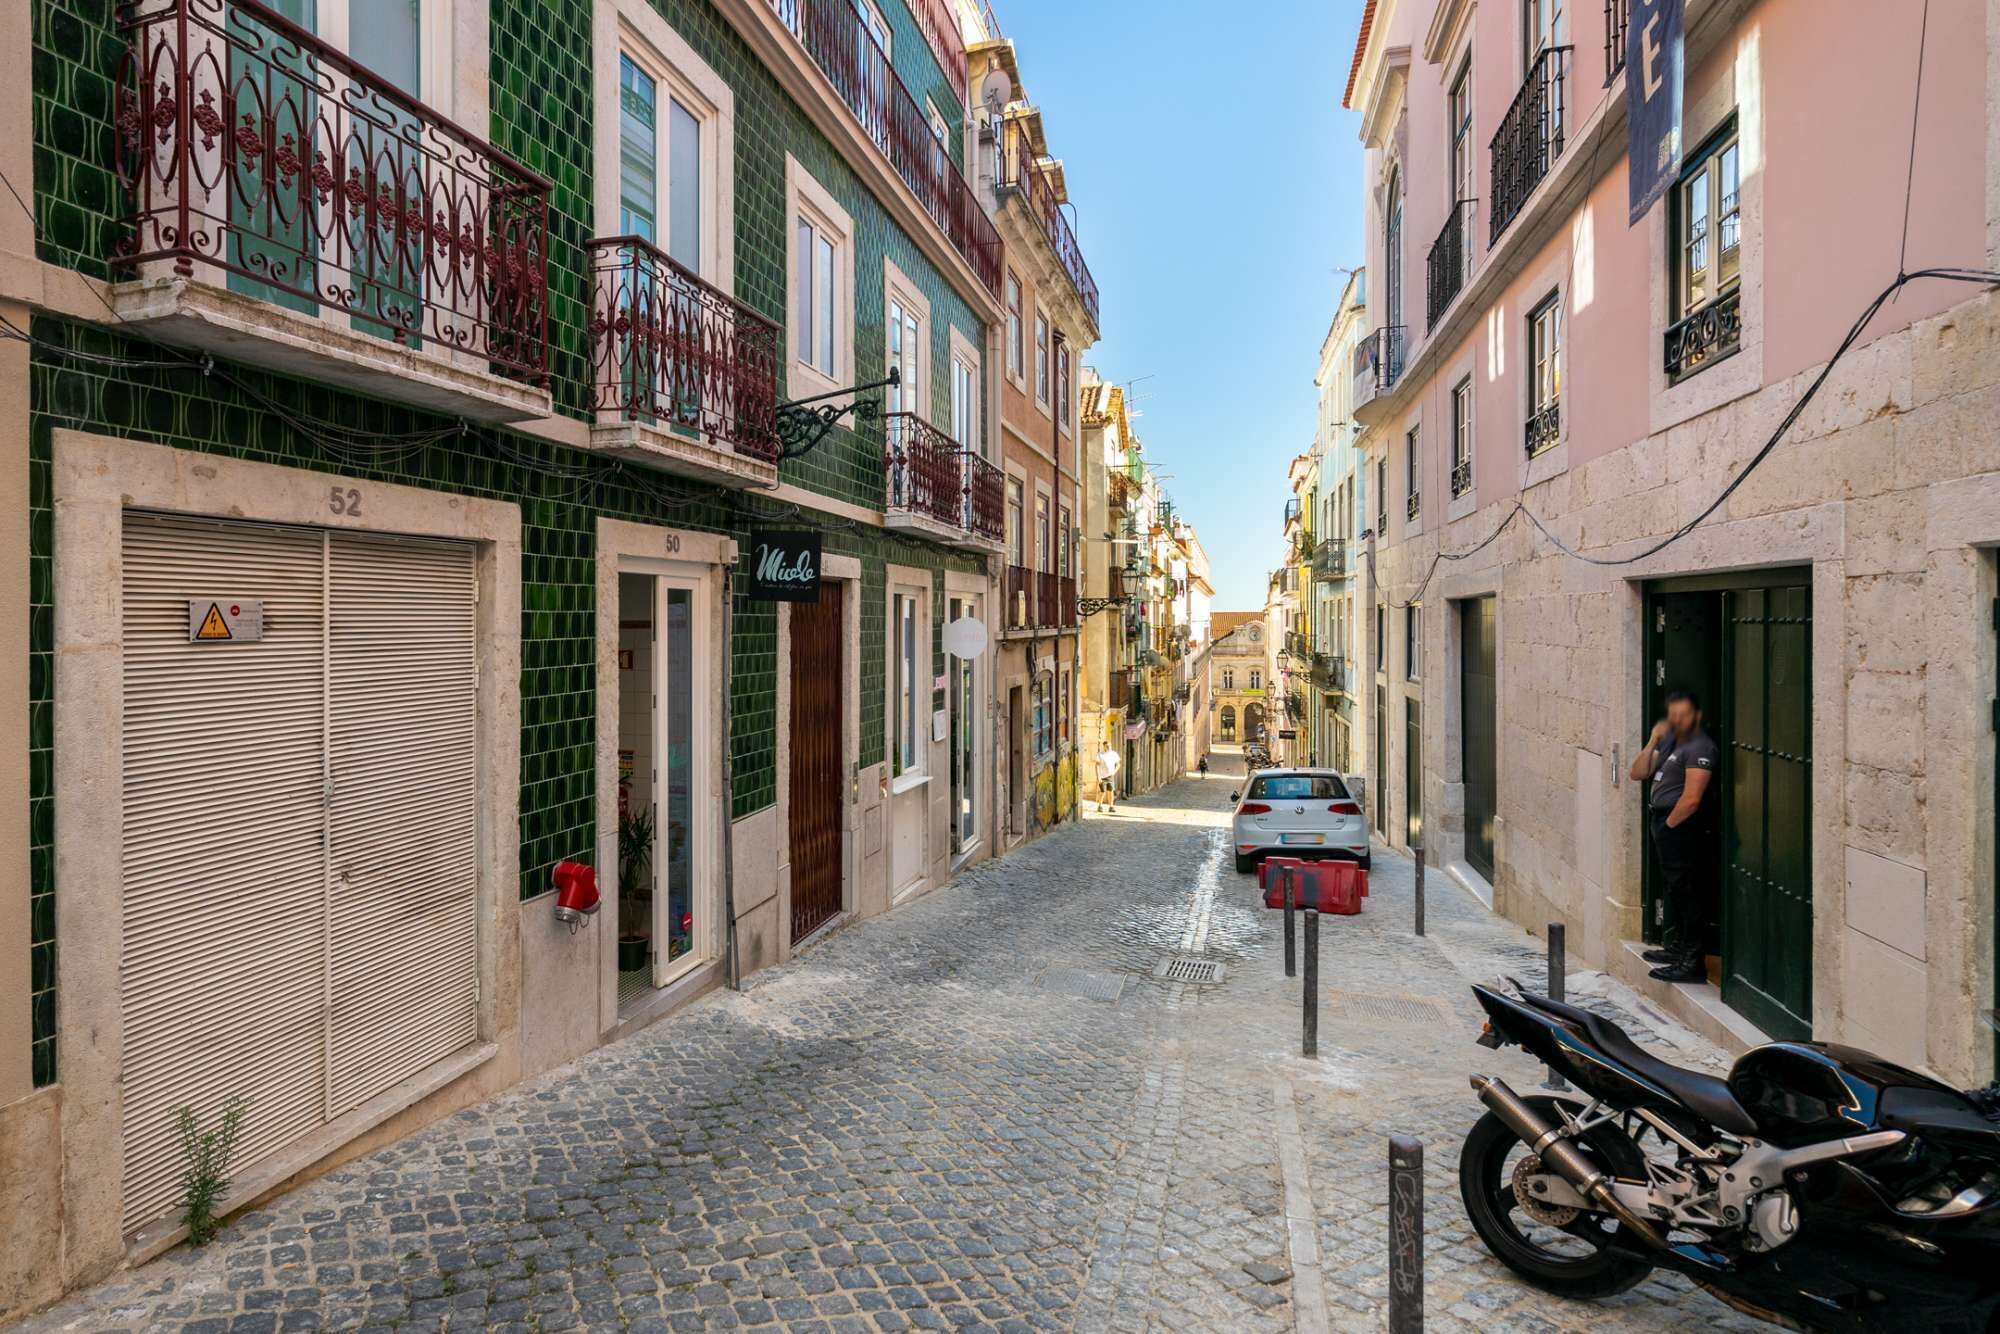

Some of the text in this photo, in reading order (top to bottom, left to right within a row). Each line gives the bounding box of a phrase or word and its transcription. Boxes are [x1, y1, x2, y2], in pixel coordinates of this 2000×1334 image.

[1642, 0, 1664, 104] E
[329, 486, 362, 517] 52
[666, 534, 680, 553] 50
